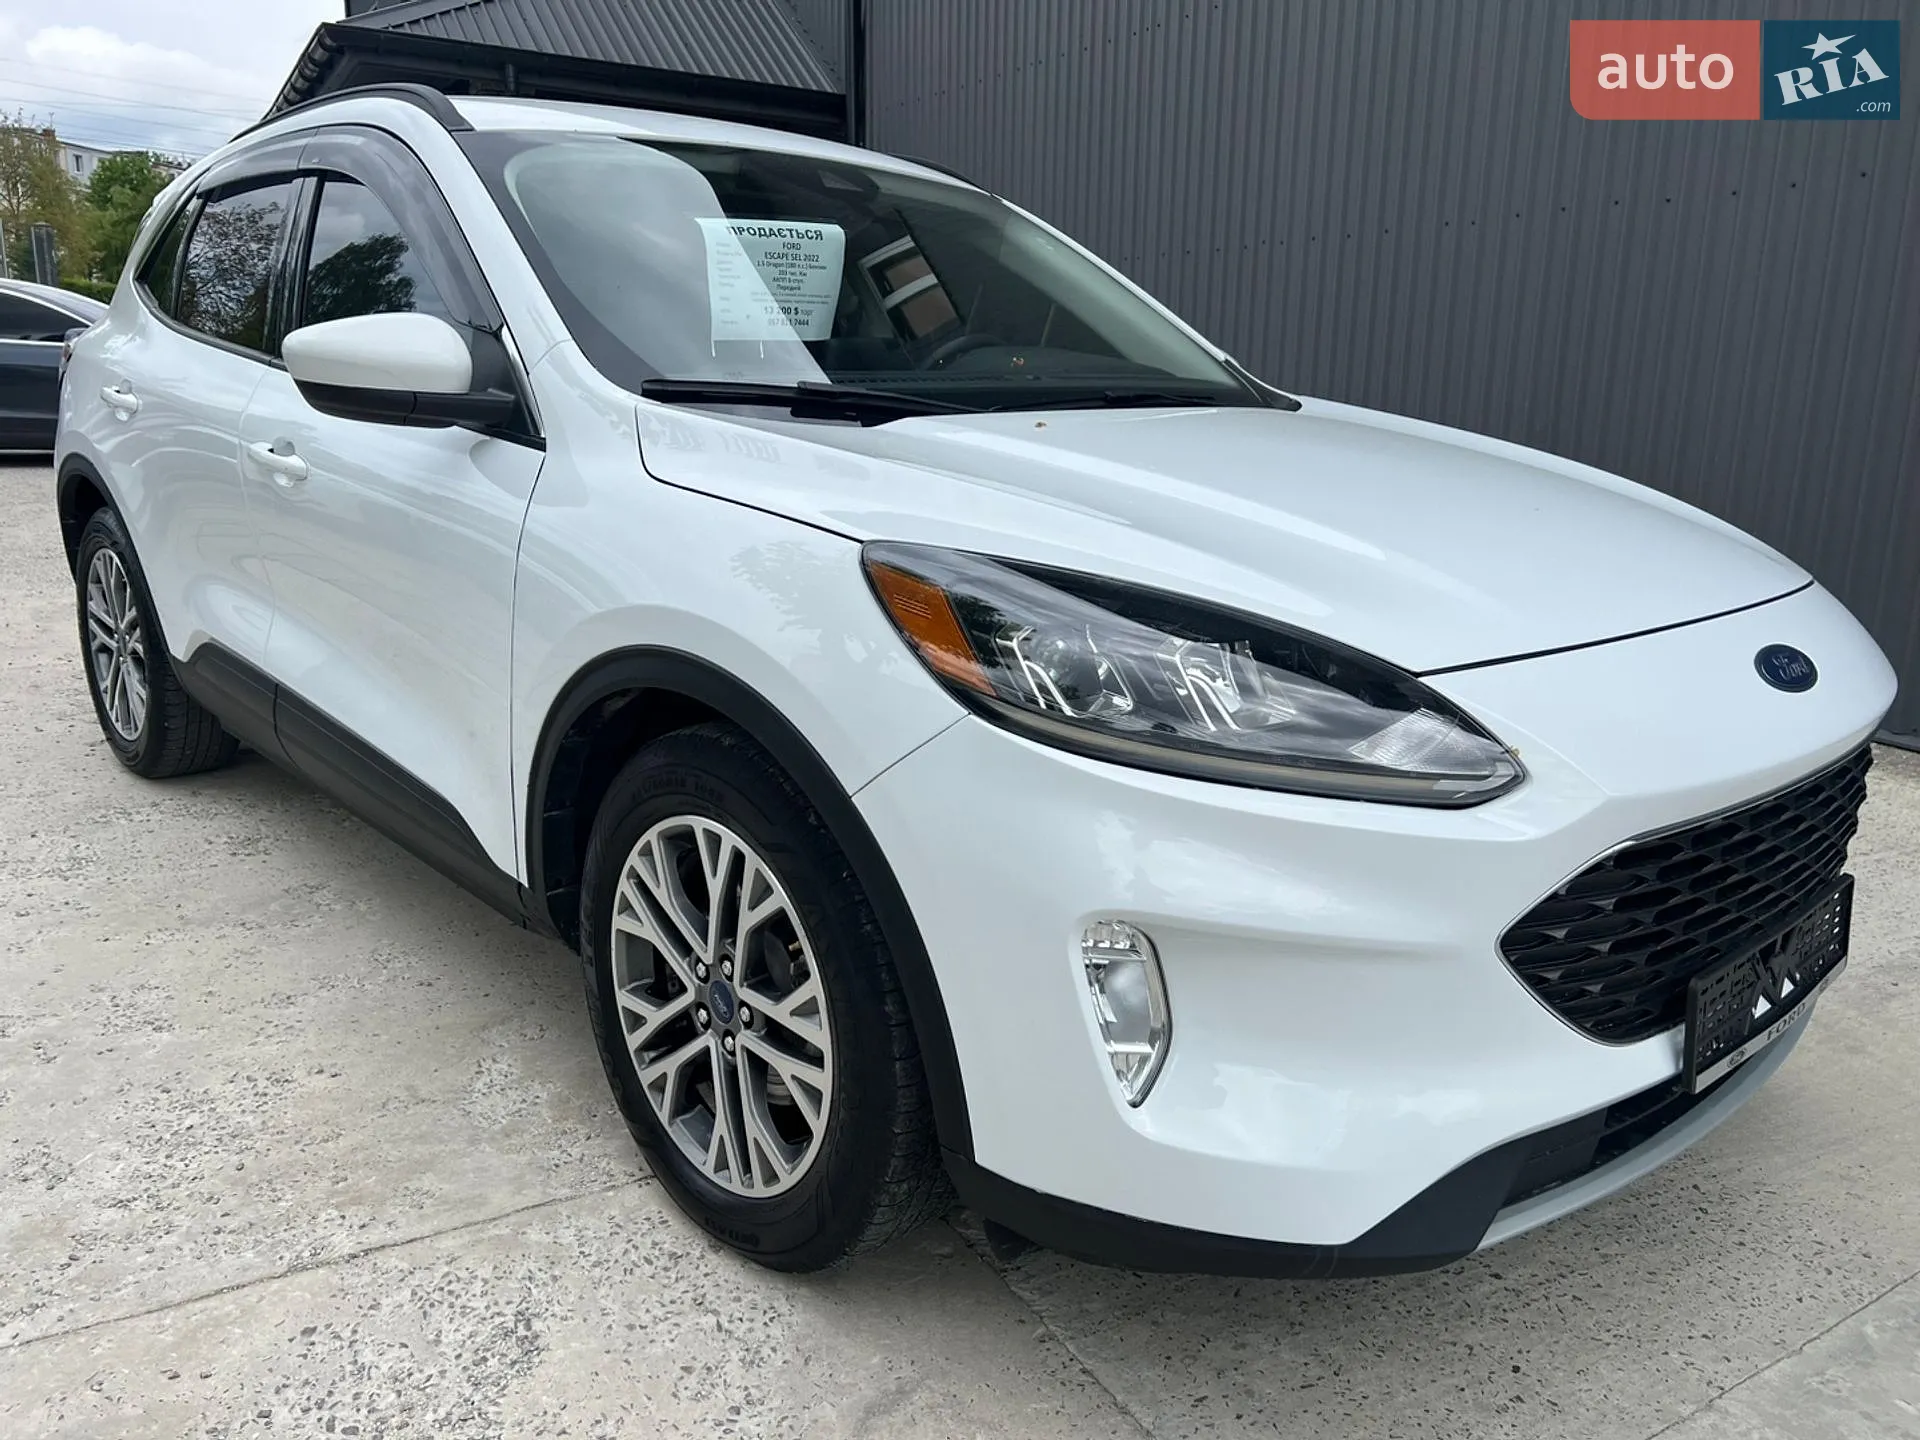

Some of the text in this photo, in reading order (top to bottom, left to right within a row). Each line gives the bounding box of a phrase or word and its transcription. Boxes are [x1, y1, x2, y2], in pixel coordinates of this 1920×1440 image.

[728, 226, 823, 241] ПРОДАЄТЬСЯ
[782, 242, 802, 251] FORD
[764, 251, 820, 263] ESCAPE SEL 2022
[1766, 1002, 1807, 1042] FORD
